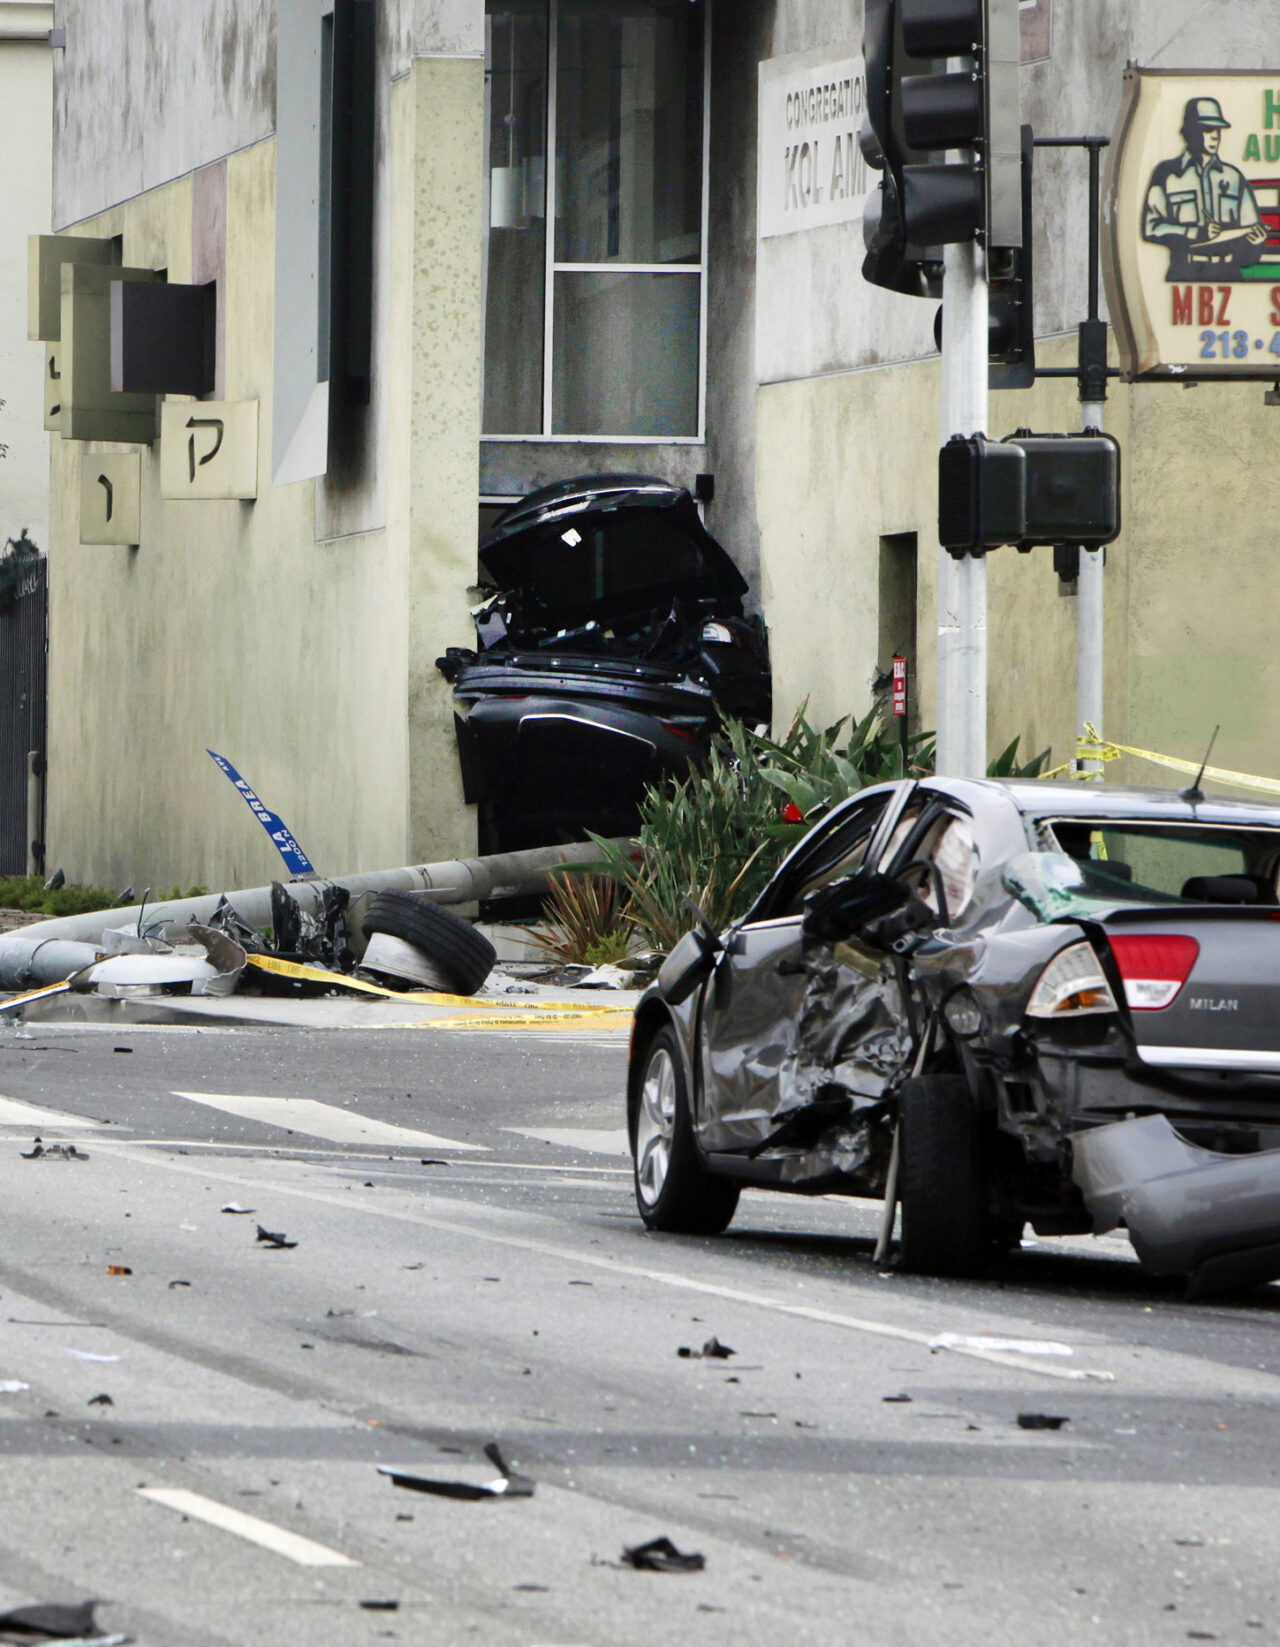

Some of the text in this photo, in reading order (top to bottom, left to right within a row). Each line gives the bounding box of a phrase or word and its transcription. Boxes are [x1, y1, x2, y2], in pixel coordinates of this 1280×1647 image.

[786, 76, 867, 131] CONGREGATION
[785, 141, 823, 211] KOL
[1171, 285, 1232, 326] MBZ
[235, 780, 272, 822] BREA
[272, 831, 292, 852] LA
[1190, 998, 1239, 1011] MILAN
